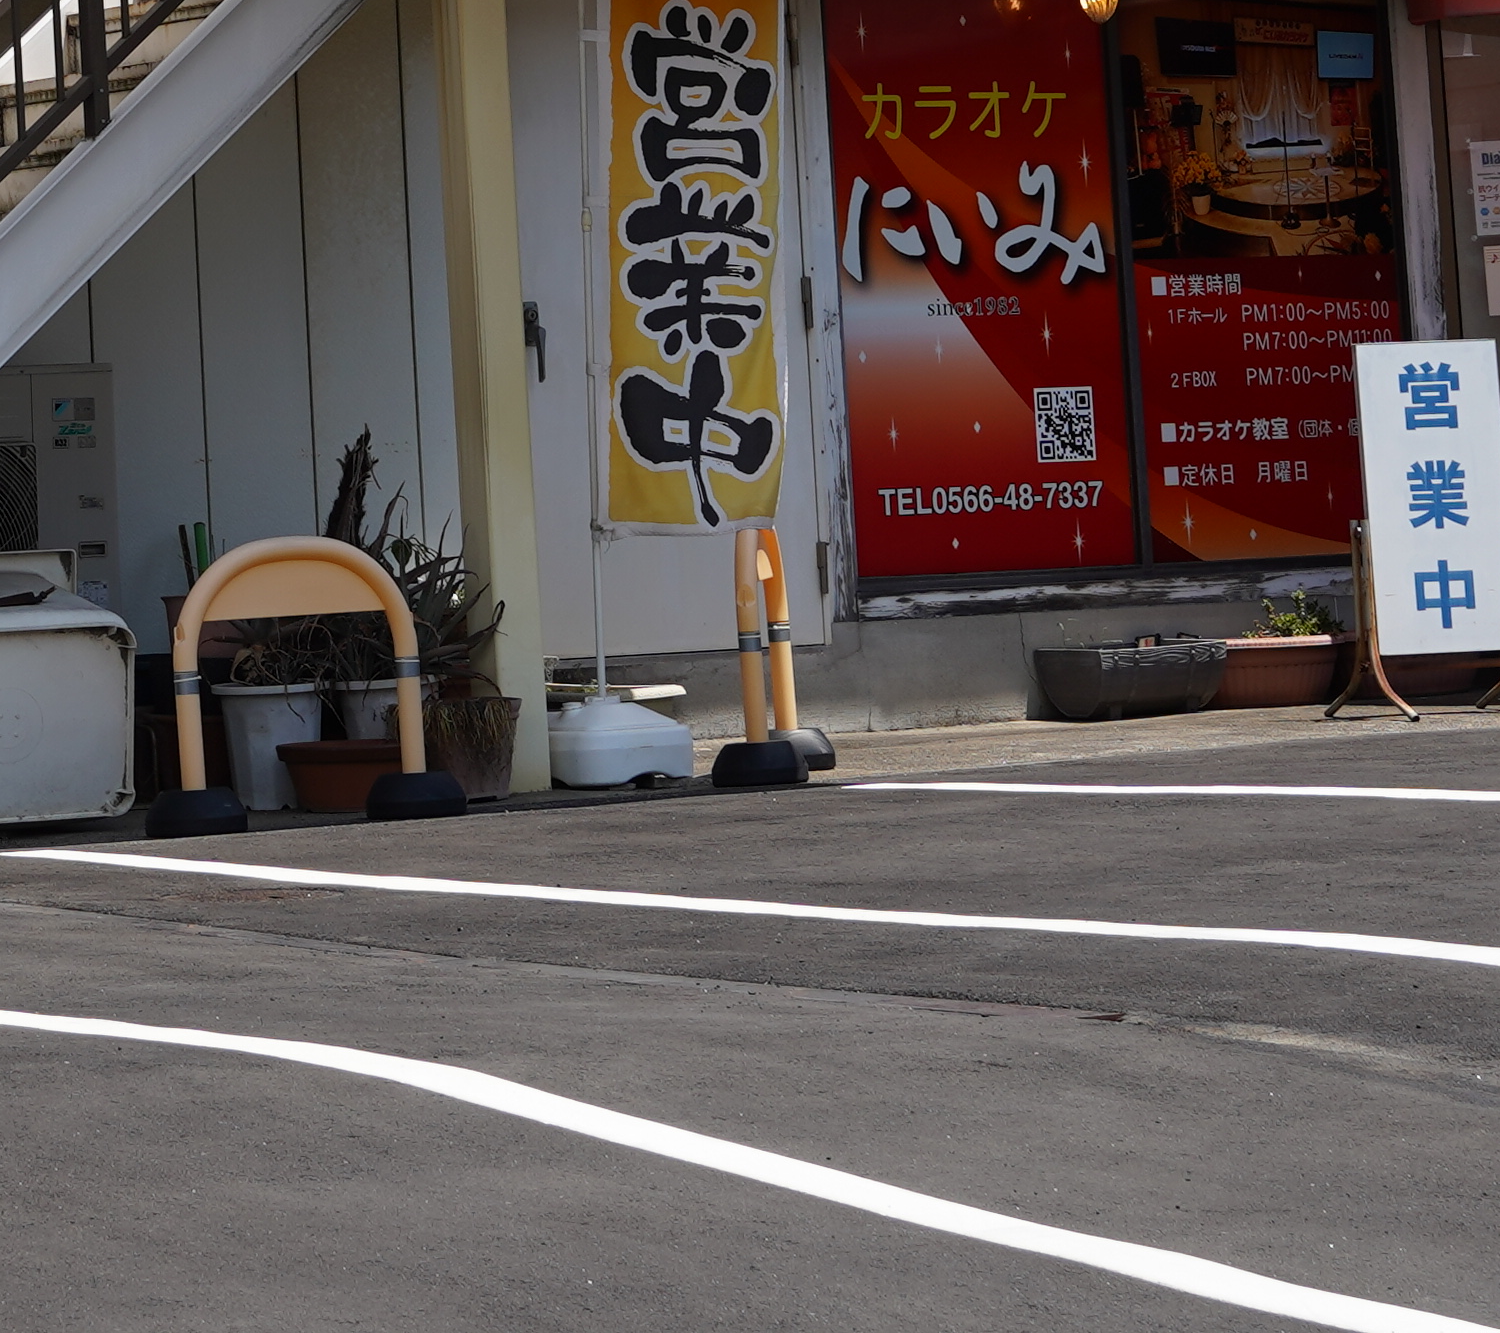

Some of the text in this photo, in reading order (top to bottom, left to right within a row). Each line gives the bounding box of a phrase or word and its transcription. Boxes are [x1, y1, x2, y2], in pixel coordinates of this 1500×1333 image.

[861, 80, 1067, 140] カラオケ
[842, 160, 1106, 285] にいみ
[618, 1, 776, 528] 営業中
[1168, 273, 1242, 298] 営業時間
[927, 296, 1021, 317] since1982
[1167, 307, 1228, 325] 1Fホール
[1246, 364, 1355, 387] PM7:00〜PM
[1178, 417, 1361, 443] カラオケ教室 (団体・個
[1181, 460, 1309, 488] 定休日 月曜日
[878, 480, 1103, 517] TEL0566-48-7337
[1398, 360, 1478, 630] 営業中
